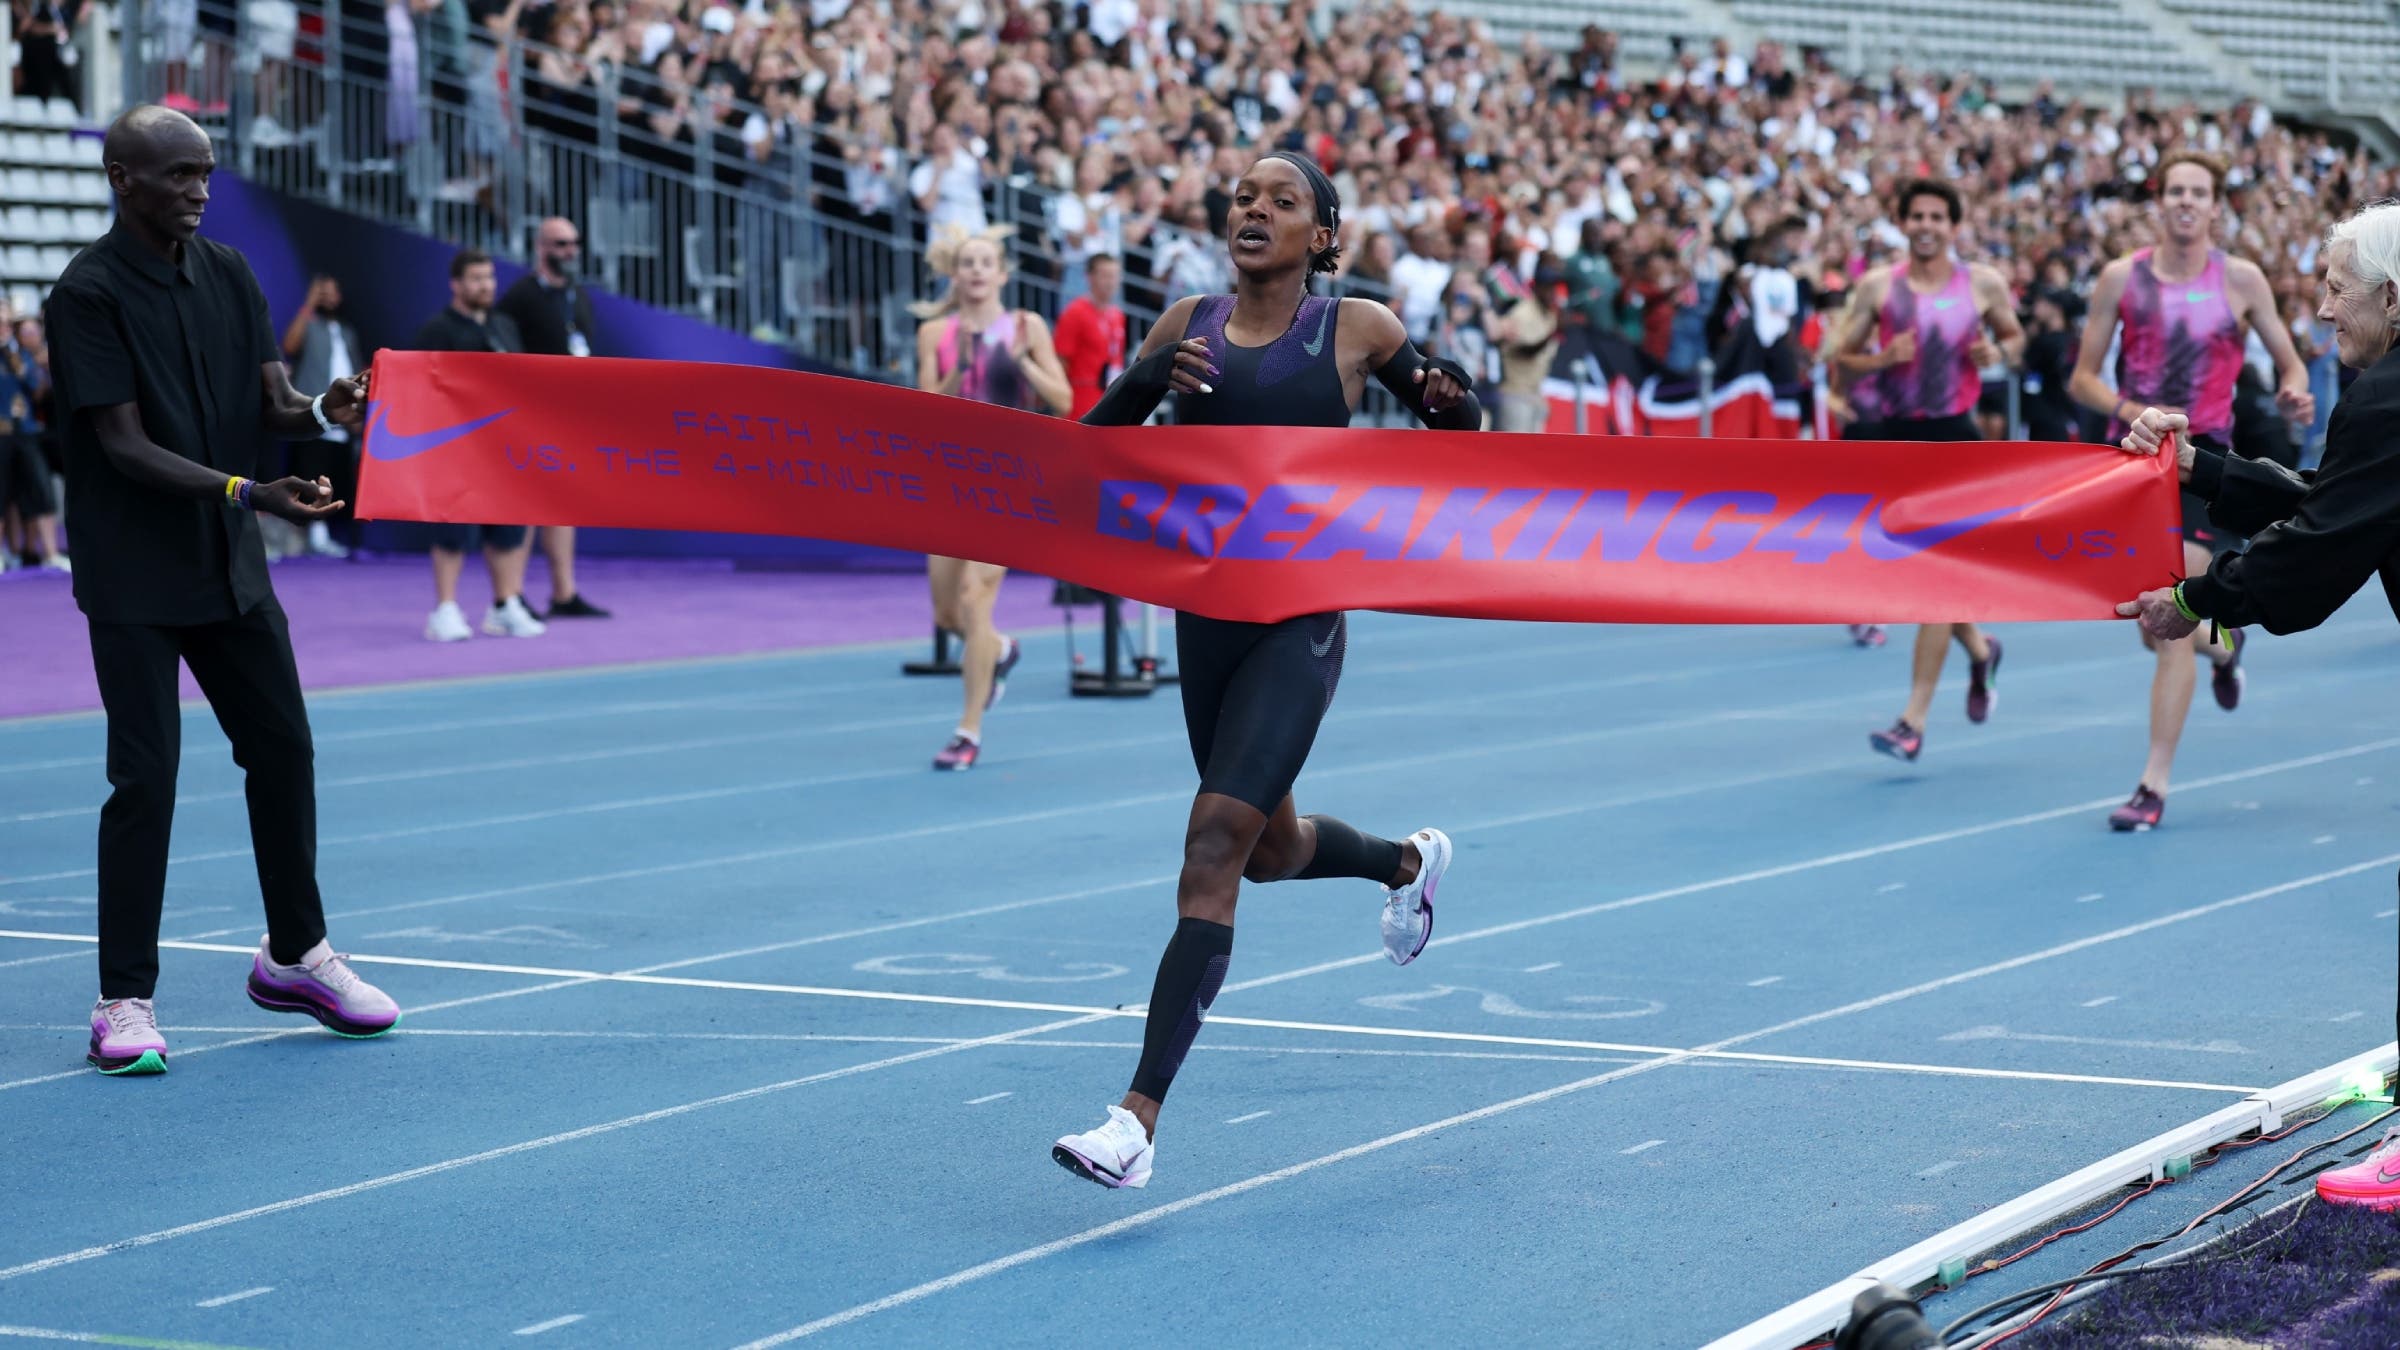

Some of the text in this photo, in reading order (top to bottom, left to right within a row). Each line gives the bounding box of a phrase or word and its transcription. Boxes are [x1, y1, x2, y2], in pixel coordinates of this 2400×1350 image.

[596, 446, 681, 476] THE
[713, 453, 927, 502] 4-MINUTE
[951, 482, 1059, 526] MILE
[673, 411, 1045, 488] FAITH KIPYEGON
[1096, 480, 1875, 563] BREAKING4
[852, 953, 1131, 983] 3
[1355, 984, 1667, 1019] 2
